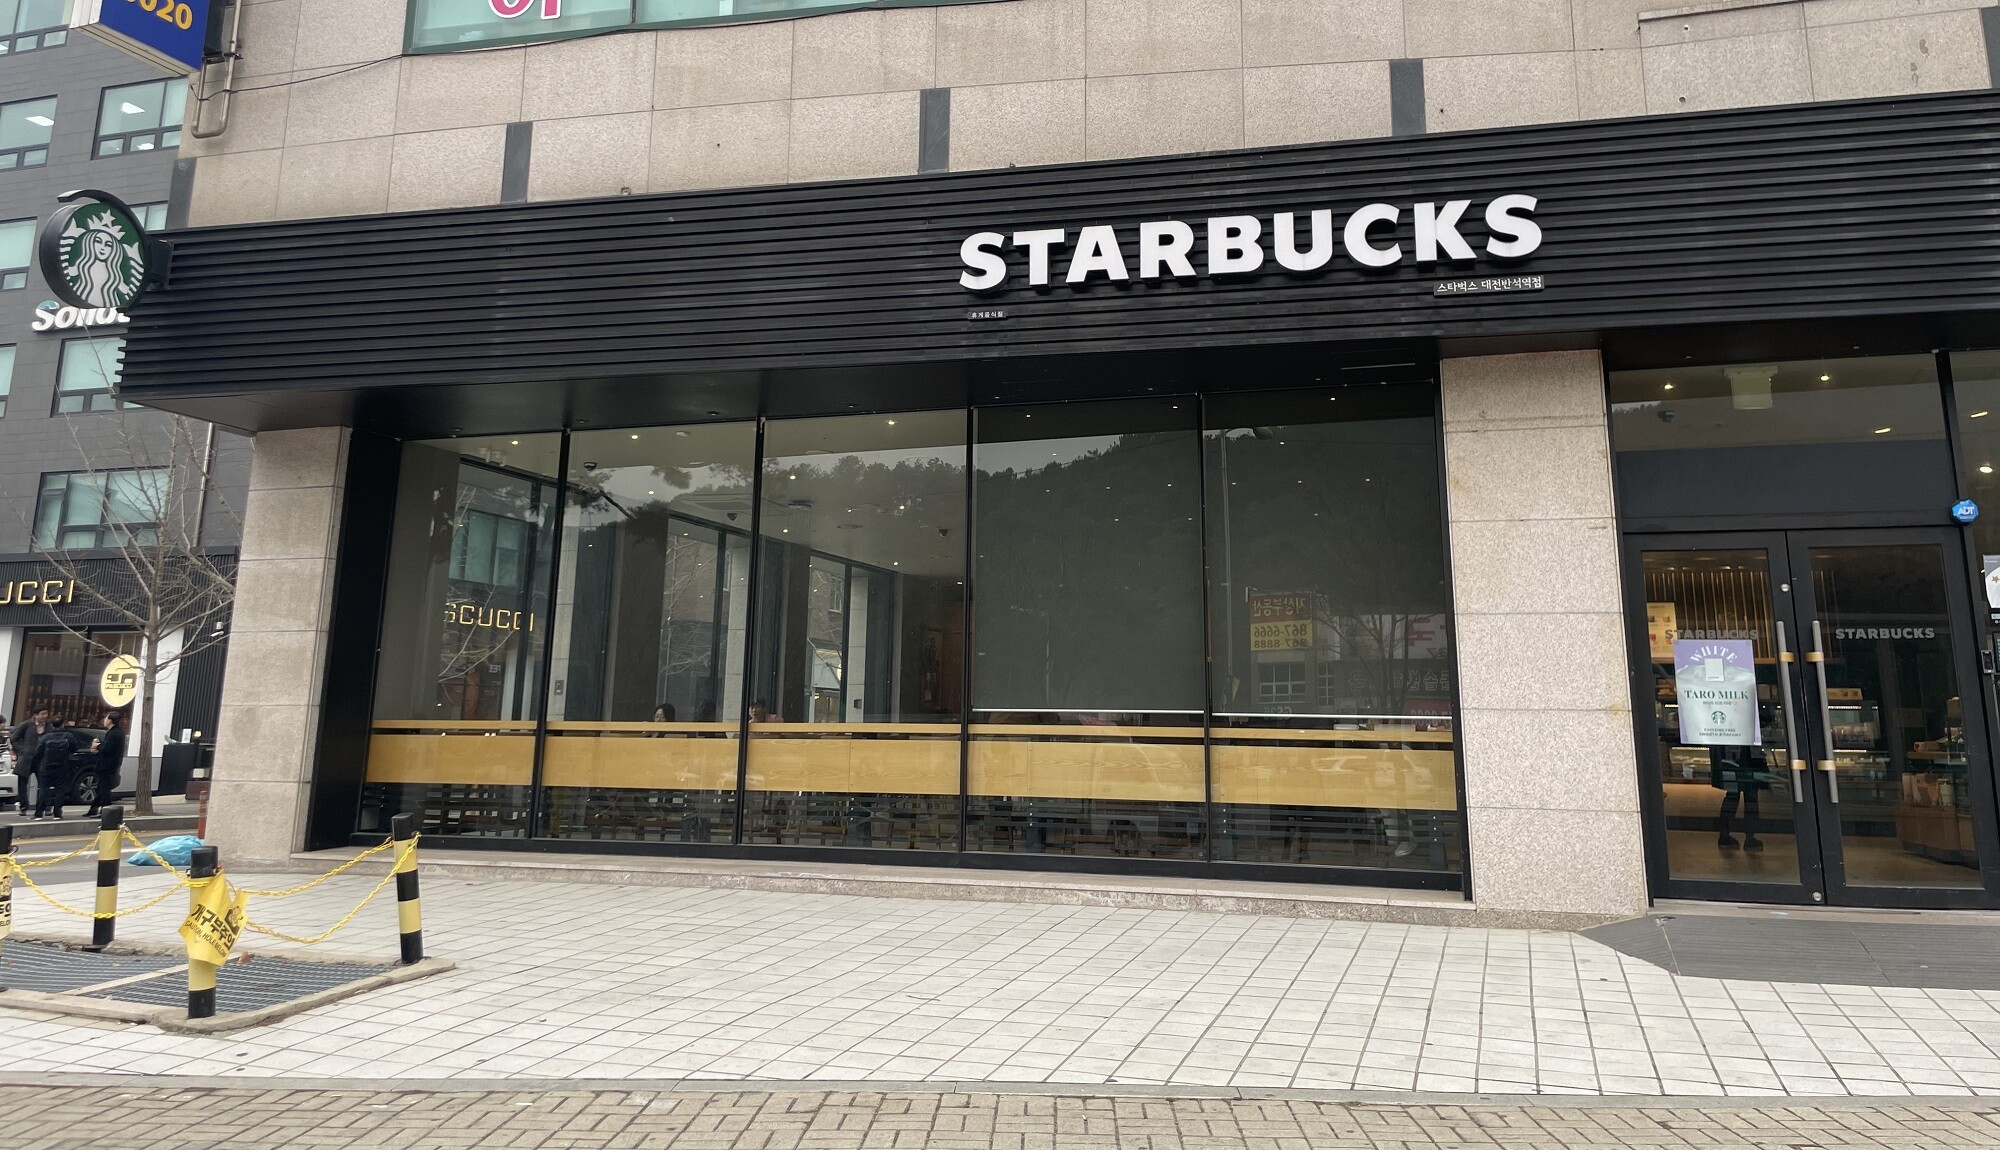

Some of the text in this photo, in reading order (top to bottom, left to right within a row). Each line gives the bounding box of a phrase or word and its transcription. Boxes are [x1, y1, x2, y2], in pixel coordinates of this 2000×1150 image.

[959, 193, 1543, 291] STARBUCKS
[1437, 276, 1542, 292] 스타벅스 대전반석역점
[1957, 505, 1975, 516] ADT
[1665, 629, 1759, 640] STARBUCKS
[1836, 627, 1935, 640] STARBUCKS
[1690, 645, 1738, 664] WHITE
[1684, 690, 1749, 700] TARO MILK
[191, 903, 236, 951] 개구부주의
[202, 933, 217, 946] HOLE
[214, 942, 228, 958] BELOW
